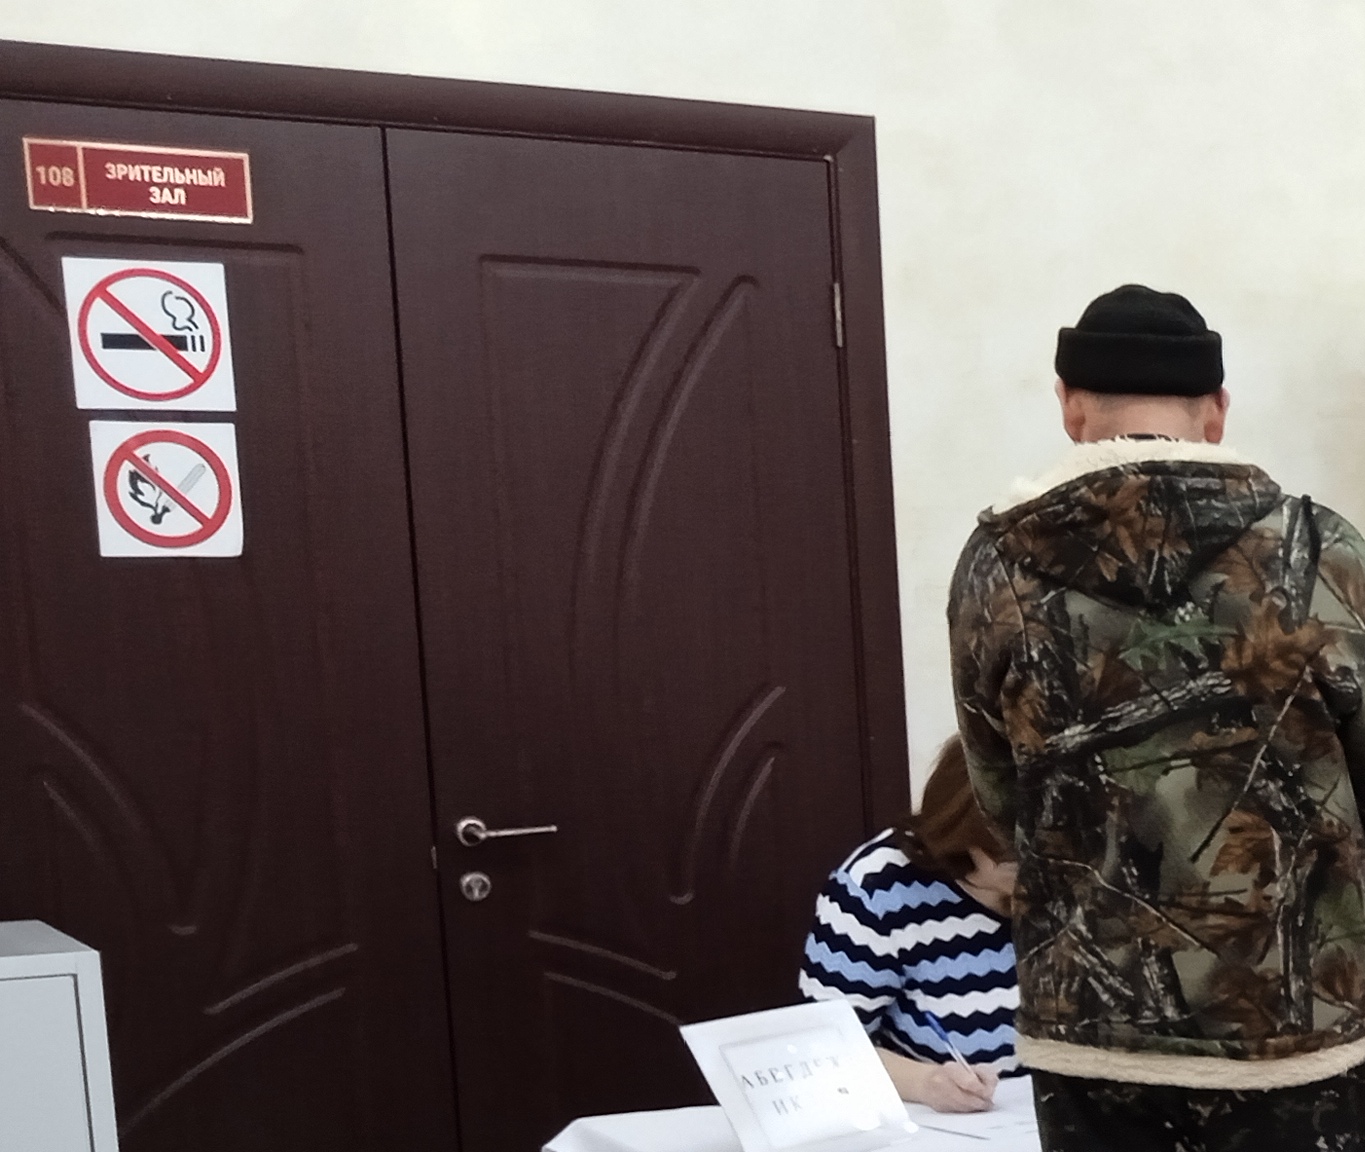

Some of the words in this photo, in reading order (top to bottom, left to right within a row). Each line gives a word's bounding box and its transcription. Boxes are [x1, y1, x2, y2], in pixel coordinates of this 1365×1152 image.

[36, 165, 75, 187] 108
[105, 162, 226, 187] ЗРИТЕЛЬНЫЙ
[149, 186, 187, 205] ЗАЛ
